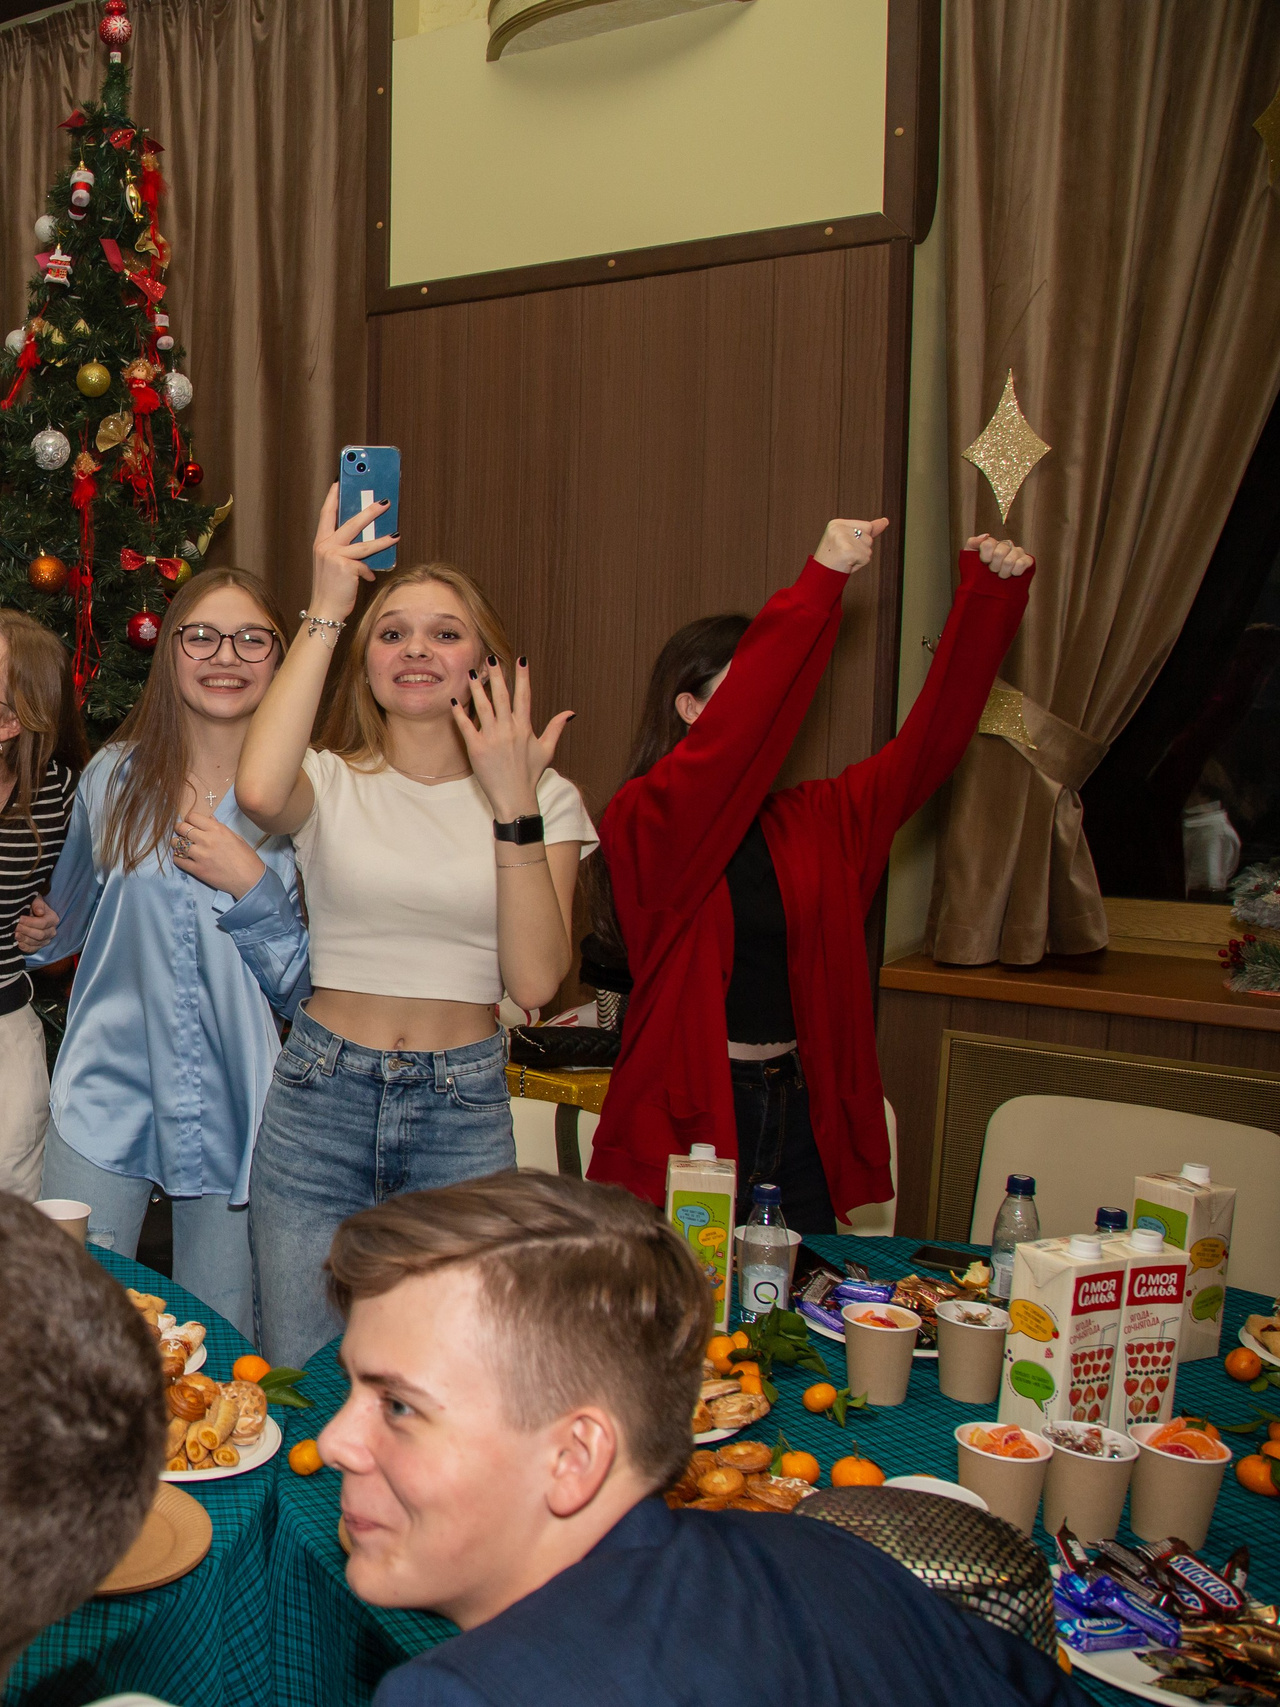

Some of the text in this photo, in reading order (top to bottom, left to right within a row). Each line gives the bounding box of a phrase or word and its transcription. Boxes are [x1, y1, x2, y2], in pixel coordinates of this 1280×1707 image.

[1089, 1278, 1117, 1293] МОЯ
[1133, 1273, 1178, 1299] Семья
[1147, 1272, 1178, 1286] МОЯ
[1077, 1282, 1117, 1308] Семья
[1129, 1309, 1154, 1323] ЯГОДА-
[1170, 1555, 1239, 1607] SNICKERS
